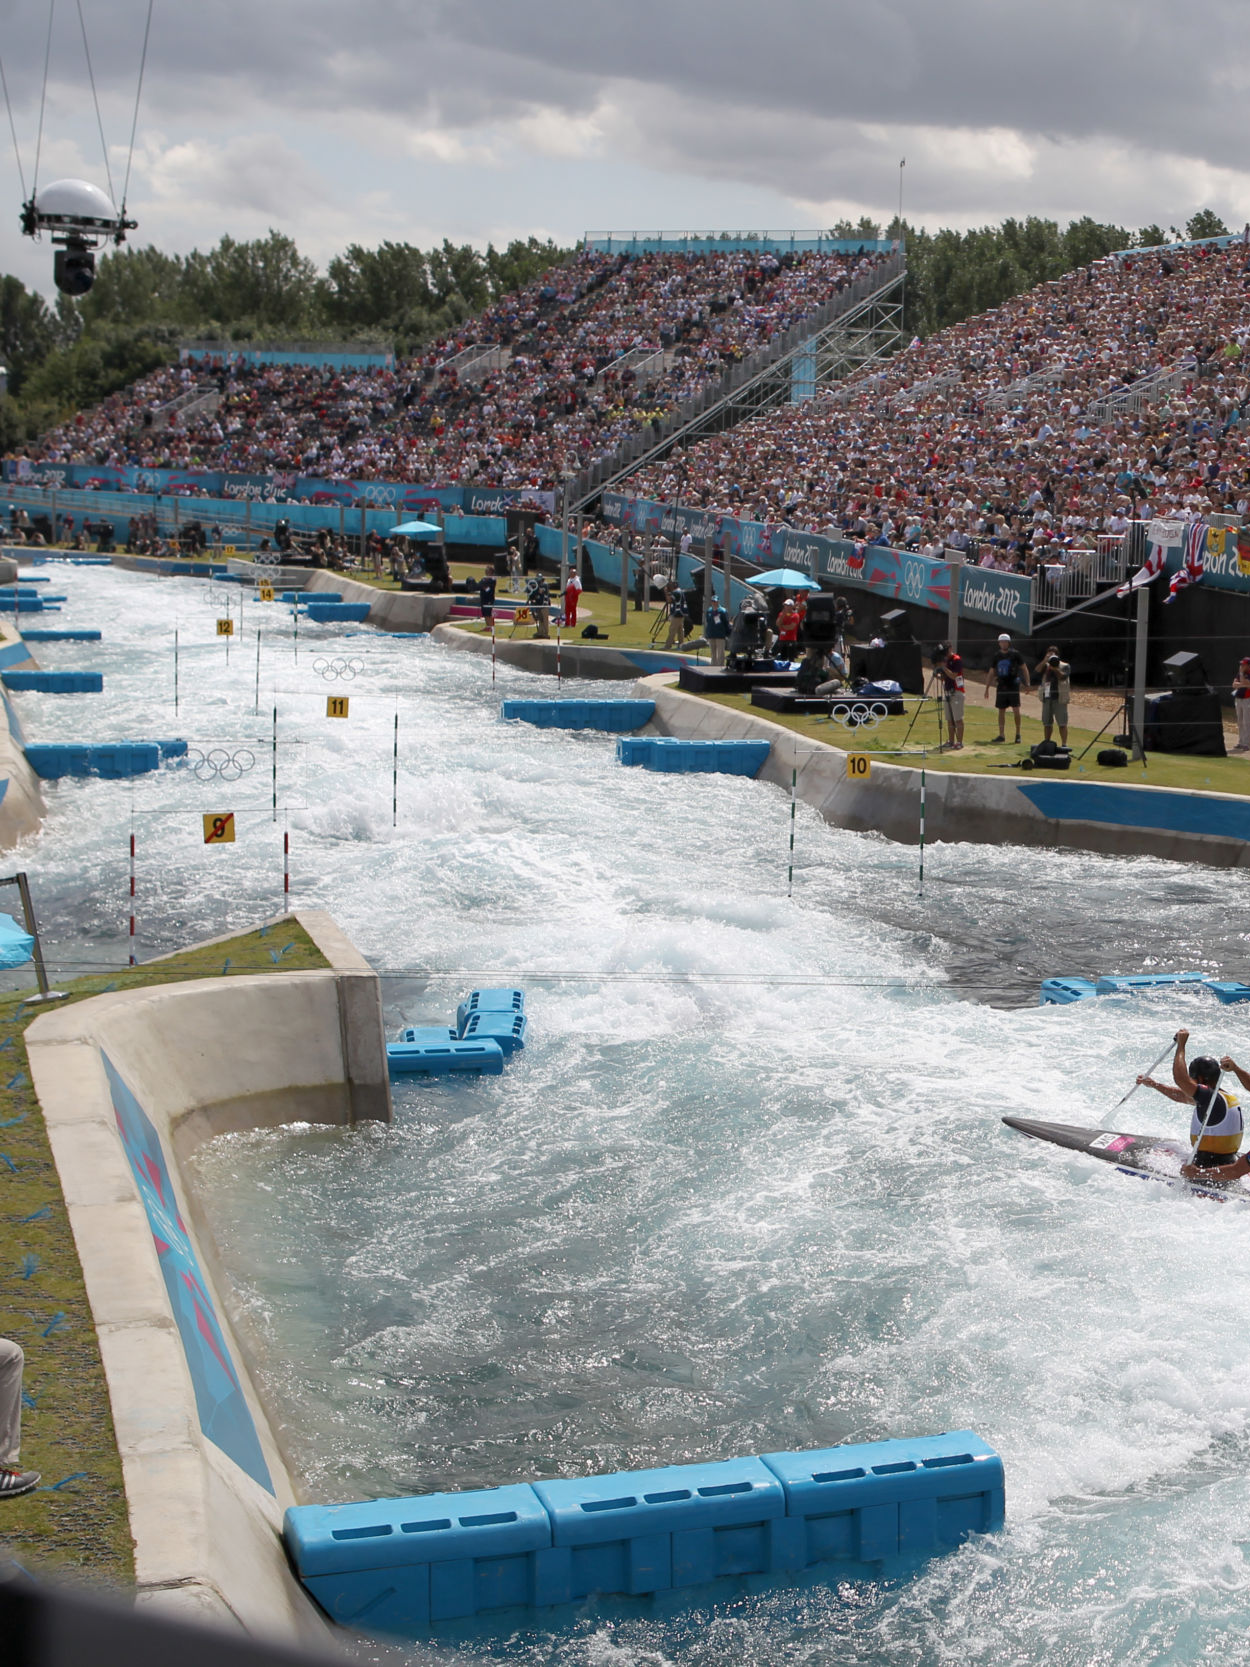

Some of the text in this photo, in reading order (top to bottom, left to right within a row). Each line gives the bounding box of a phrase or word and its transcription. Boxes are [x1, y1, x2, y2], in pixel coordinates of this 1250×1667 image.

[224, 480, 262, 497] London
[784, 540, 805, 565] London
[262, 589, 272, 600] 14
[964, 580, 1020, 618] London 2012
[218, 622, 231, 633] 12
[331, 699, 344, 715] 11
[850, 756, 867, 774] 10
[212, 817, 225, 838] 9
